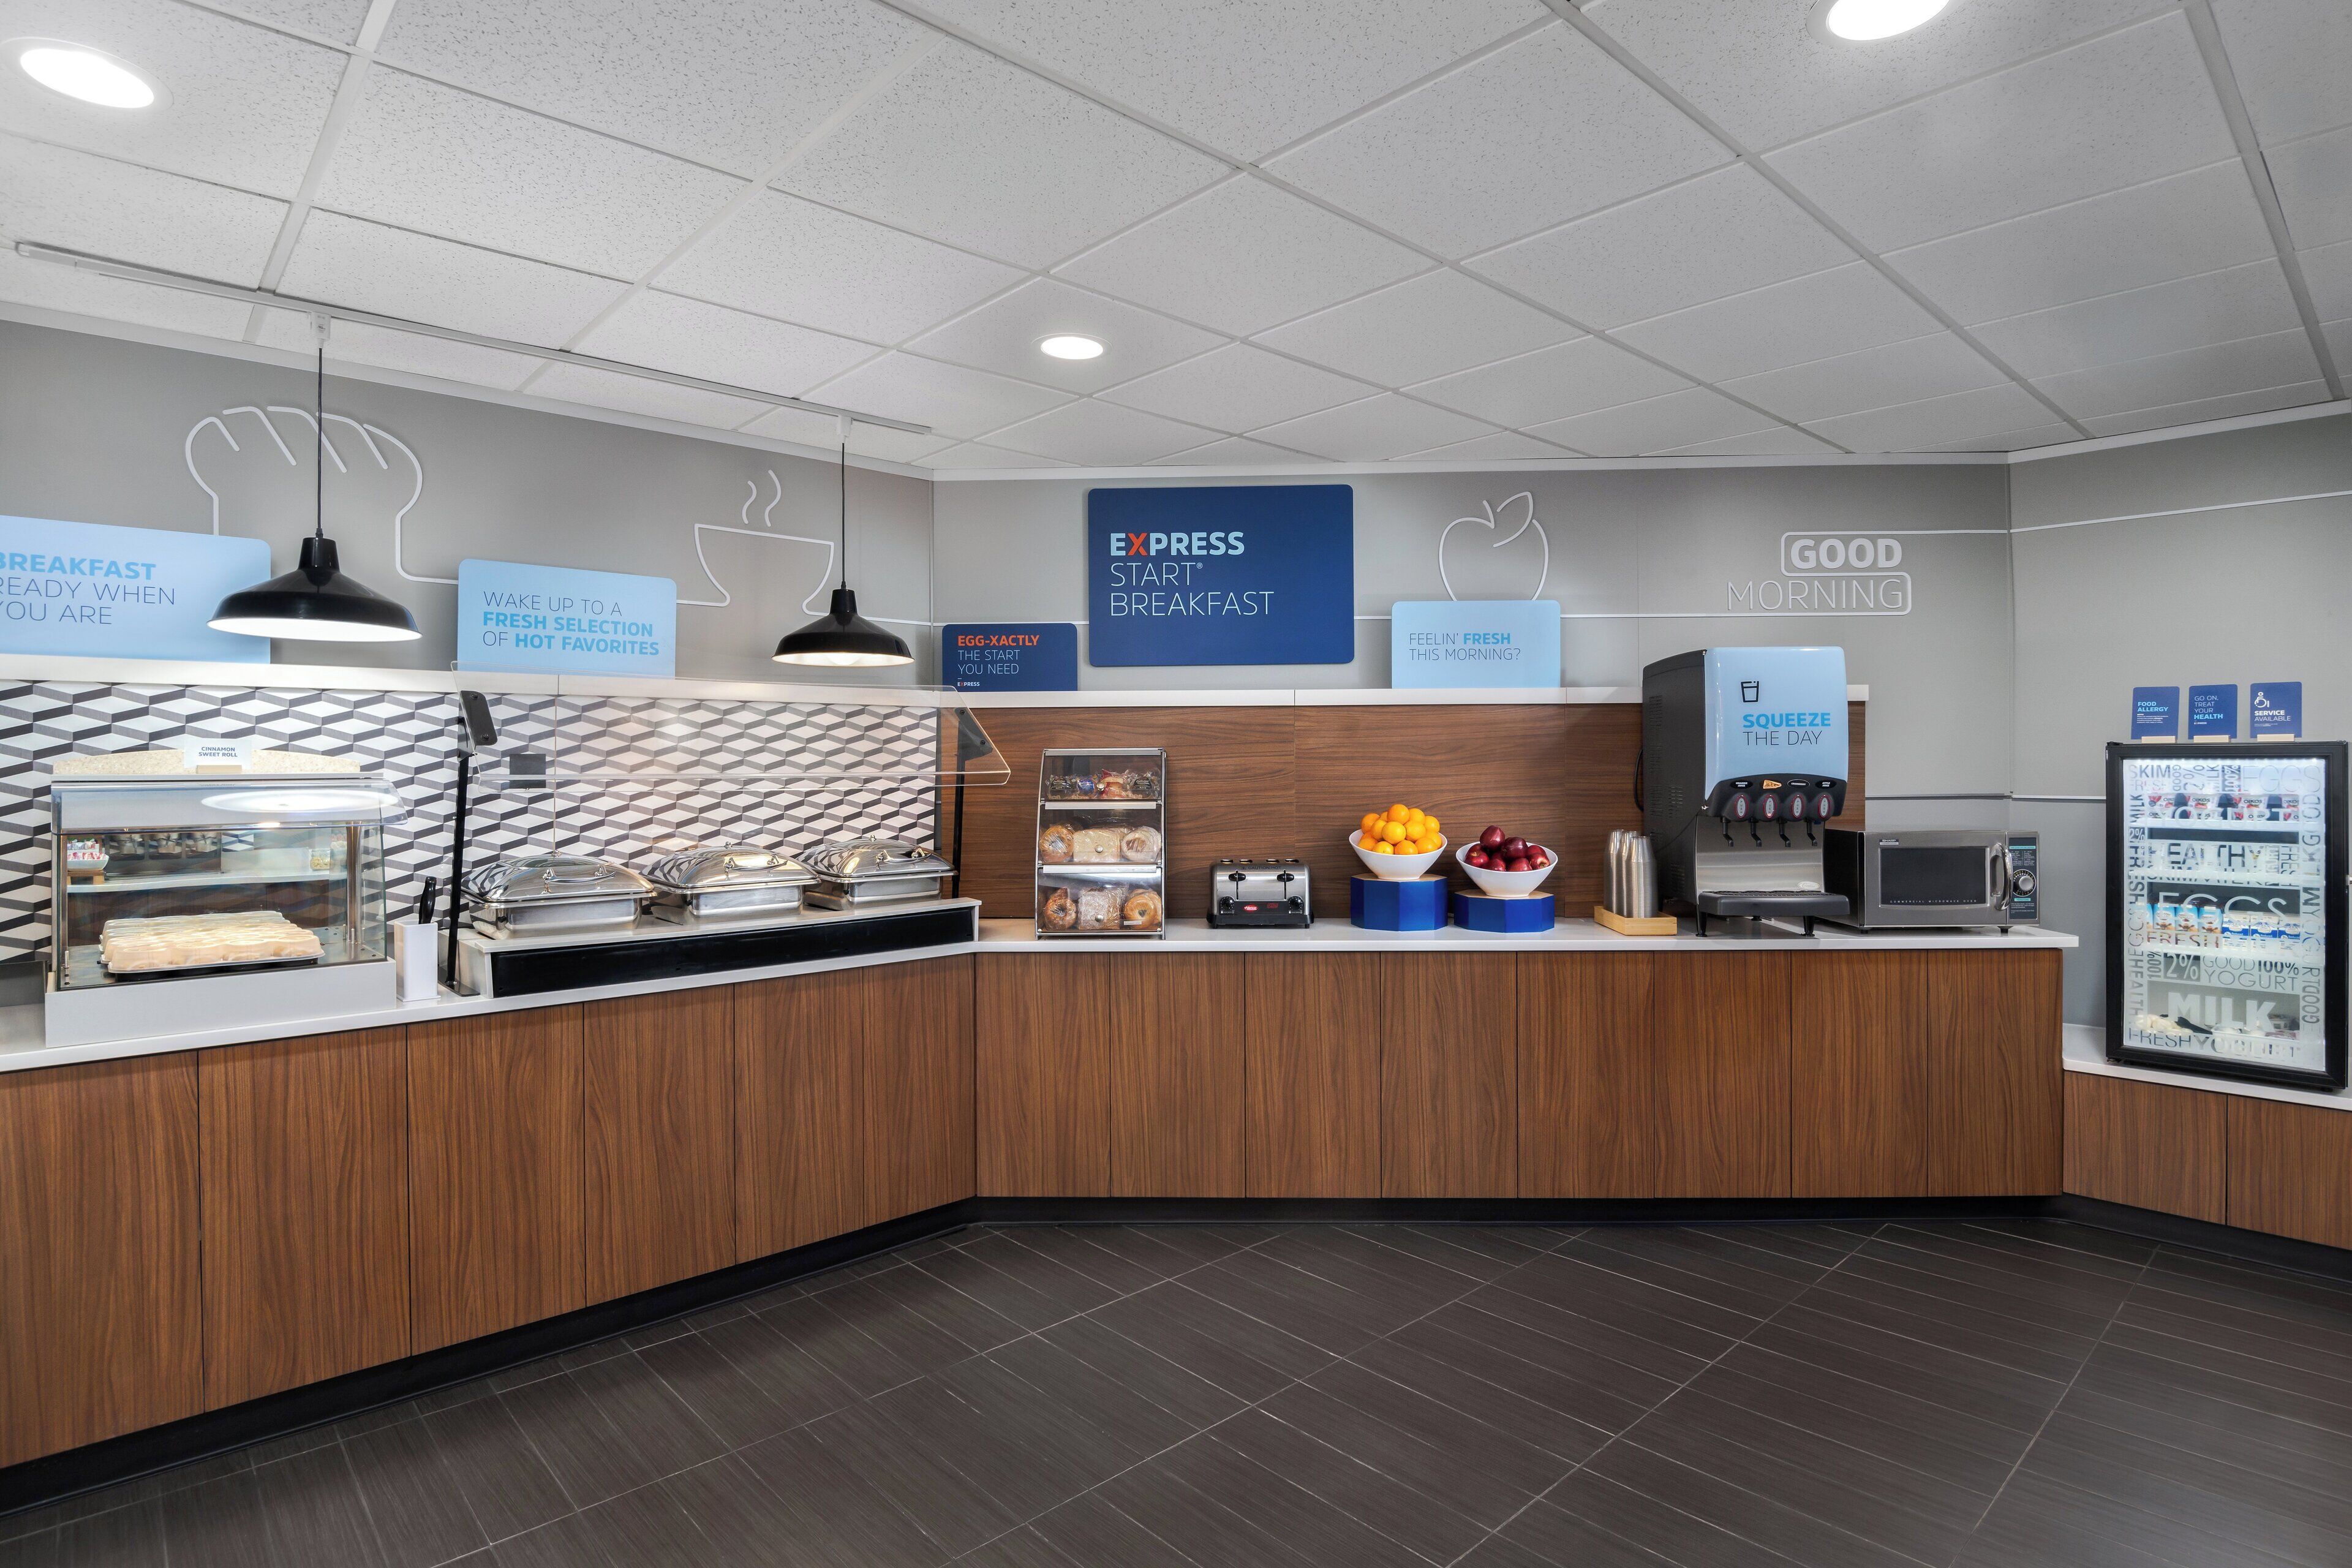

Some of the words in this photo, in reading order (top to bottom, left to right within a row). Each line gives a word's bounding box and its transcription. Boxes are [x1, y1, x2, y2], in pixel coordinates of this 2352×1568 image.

[1110, 532, 1245, 556] EXPRESS
[1790, 538, 1902, 569] GOOD
[93, 582, 175, 605] WHEN
[483, 591, 541, 610] WAKE
[549, 597, 573, 612] UP
[581, 599, 604, 615] TO
[610, 602, 622, 617] A
[1110, 591, 1275, 616] BREAKFAST
[1727, 579, 1902, 610] MORNING
[59, 605, 112, 625] ARE
[483, 611, 547, 630] FRESH
[554, 616, 653, 637] SELECTION
[483, 631, 508, 646] OF
[515, 633, 554, 649] HOT
[562, 636, 659, 656] FAVORITES
[957, 635, 1039, 646] EGG-XACTLY
[1463, 633, 1510, 645] FRESH
[957, 650, 980, 660] THE
[984, 649, 1020, 660] START
[1409, 648, 1439, 661] THIS
[1445, 648, 1521, 660] MORNING?
[957, 664, 983, 674] YOU
[988, 663, 1019, 674] NEED
[1743, 712, 1831, 729] SQUEEZE
[1743, 731, 1779, 745] THE
[1788, 730, 1822, 745] DAY
[2128, 764, 2171, 779] SKIM
[2173, 764, 2181, 791] GOOD
[2242, 765, 2321, 793] EGGS
[2147, 951, 2162, 979] 100%
[2166, 953, 2198, 979] 2%
[2203, 956, 2255, 971] GOOD
[2258, 960, 2299, 976] 100%
[2128, 959, 2144, 1025] HEALTH
[2205, 970, 2299, 991] YOGURT
[2168, 992, 2276, 1033] MILK
[2301, 985, 2321, 1024] GOOD
[2129, 1027, 2191, 1048] FRESH
